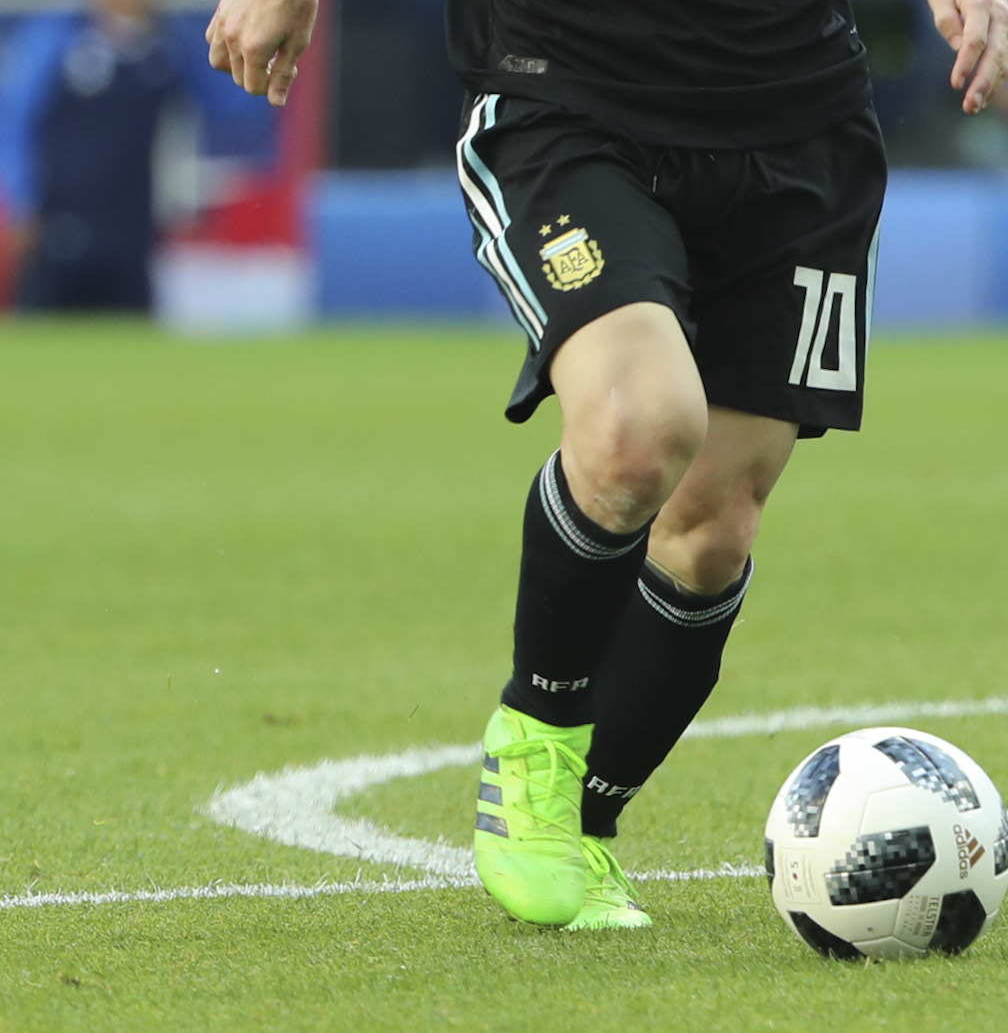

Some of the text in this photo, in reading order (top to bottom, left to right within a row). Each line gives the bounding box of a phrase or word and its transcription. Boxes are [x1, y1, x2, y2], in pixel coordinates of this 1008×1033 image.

[558, 247, 589, 275] AFA
[788, 266, 857, 391] 10
[953, 824, 968, 879] adidas
